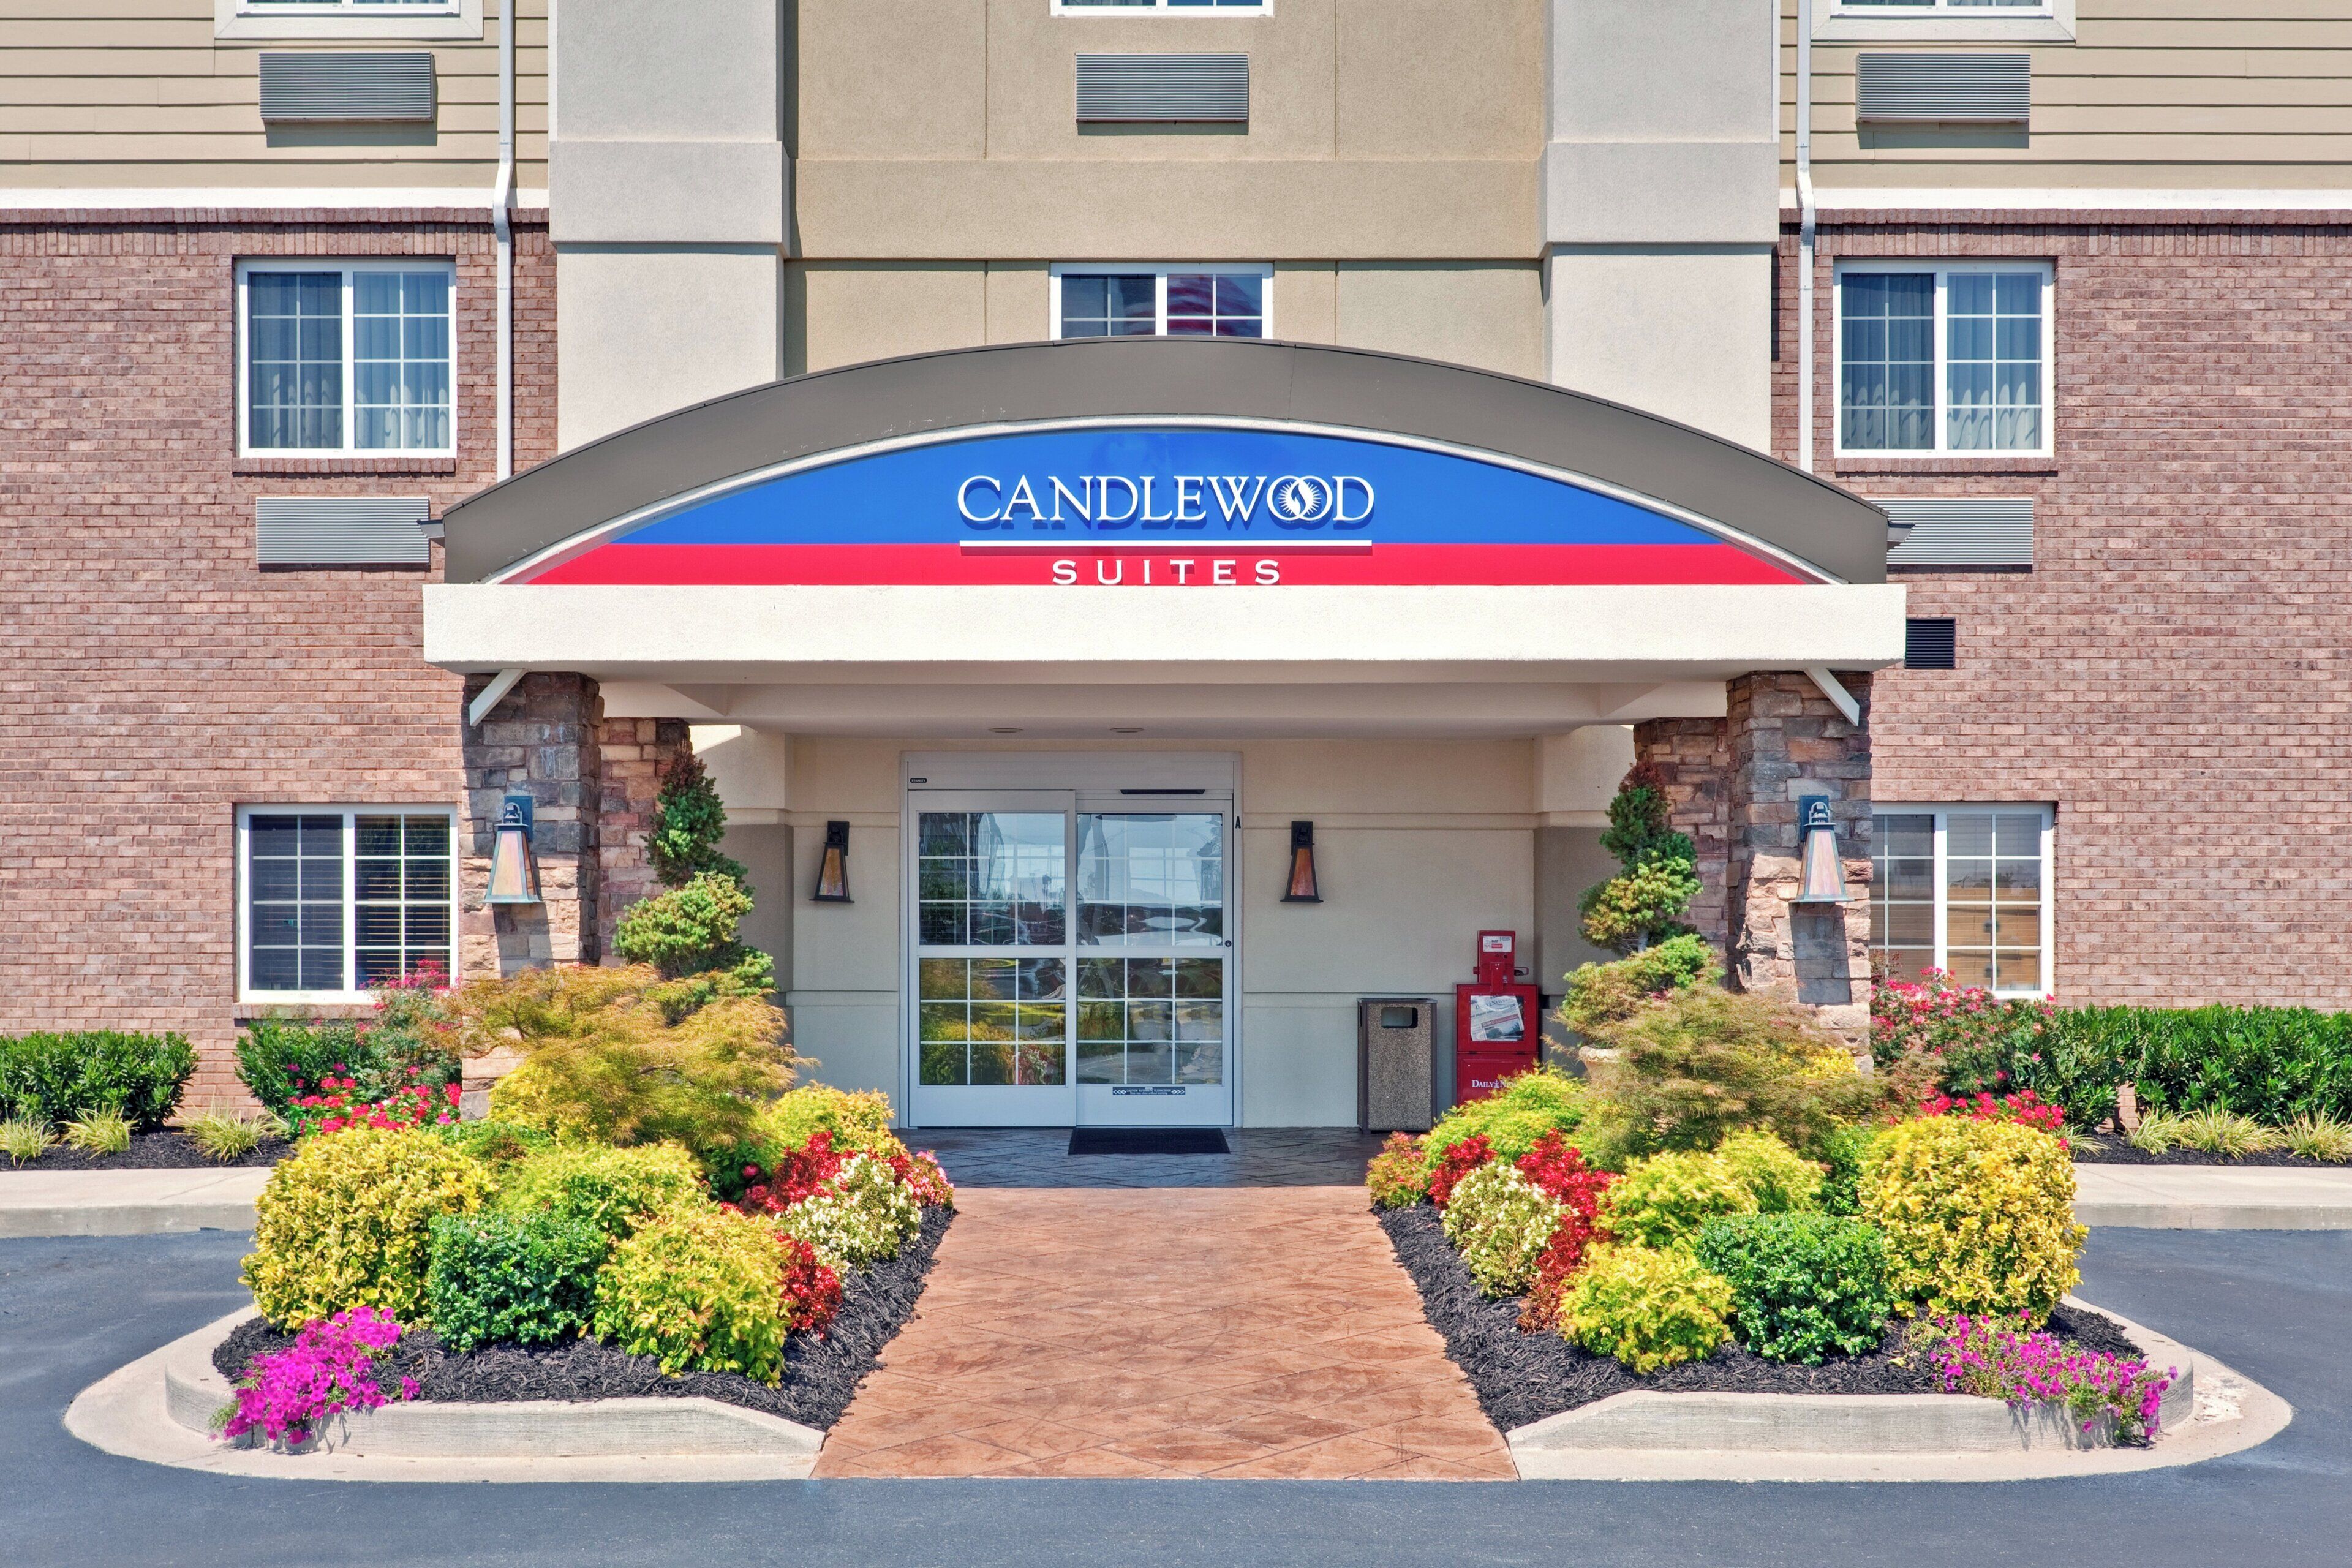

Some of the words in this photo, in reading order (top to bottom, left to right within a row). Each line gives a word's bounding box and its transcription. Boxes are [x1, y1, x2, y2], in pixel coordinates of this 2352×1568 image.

[957, 474, 1374, 522] CANDLEWOOD
[1052, 559, 1281, 585] SUITES
[1235, 816, 1241, 829] A
